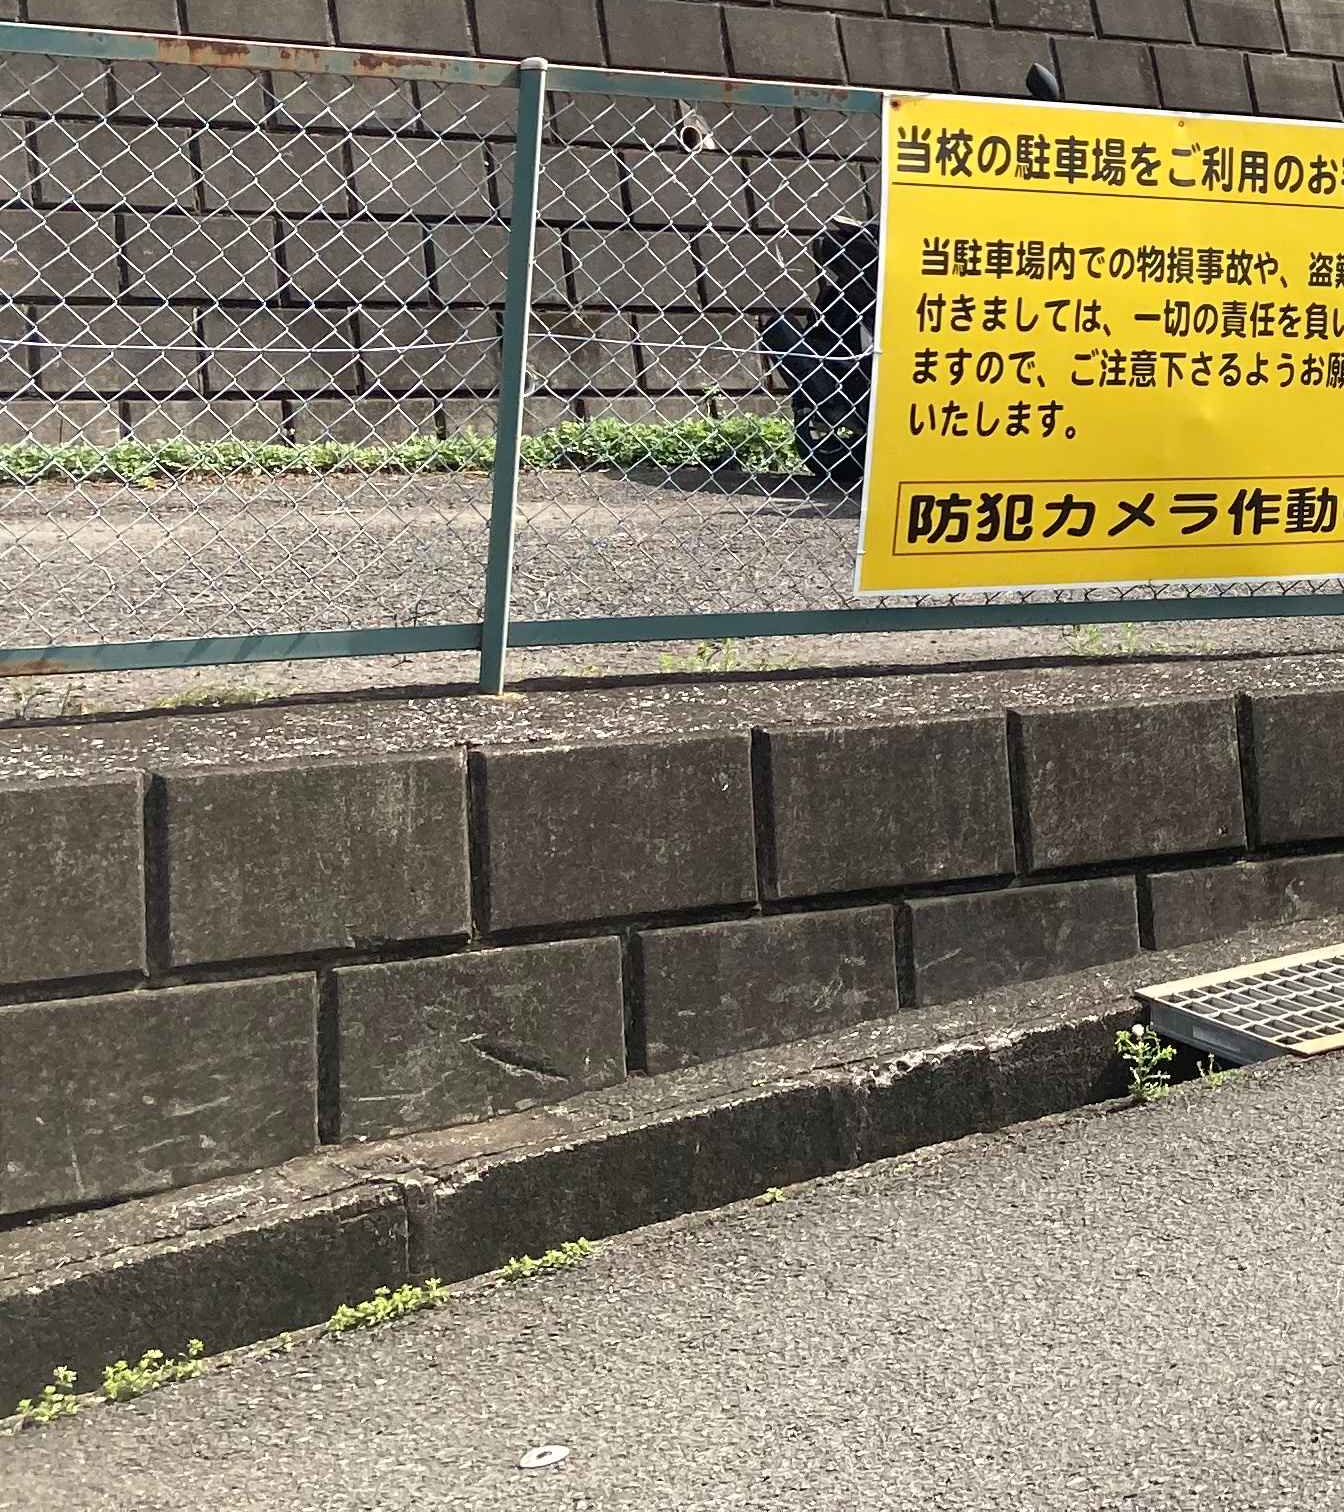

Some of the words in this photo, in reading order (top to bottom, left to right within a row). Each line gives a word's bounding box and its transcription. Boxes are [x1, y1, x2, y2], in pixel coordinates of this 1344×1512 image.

[909, 399, 1076, 440] いたします。
